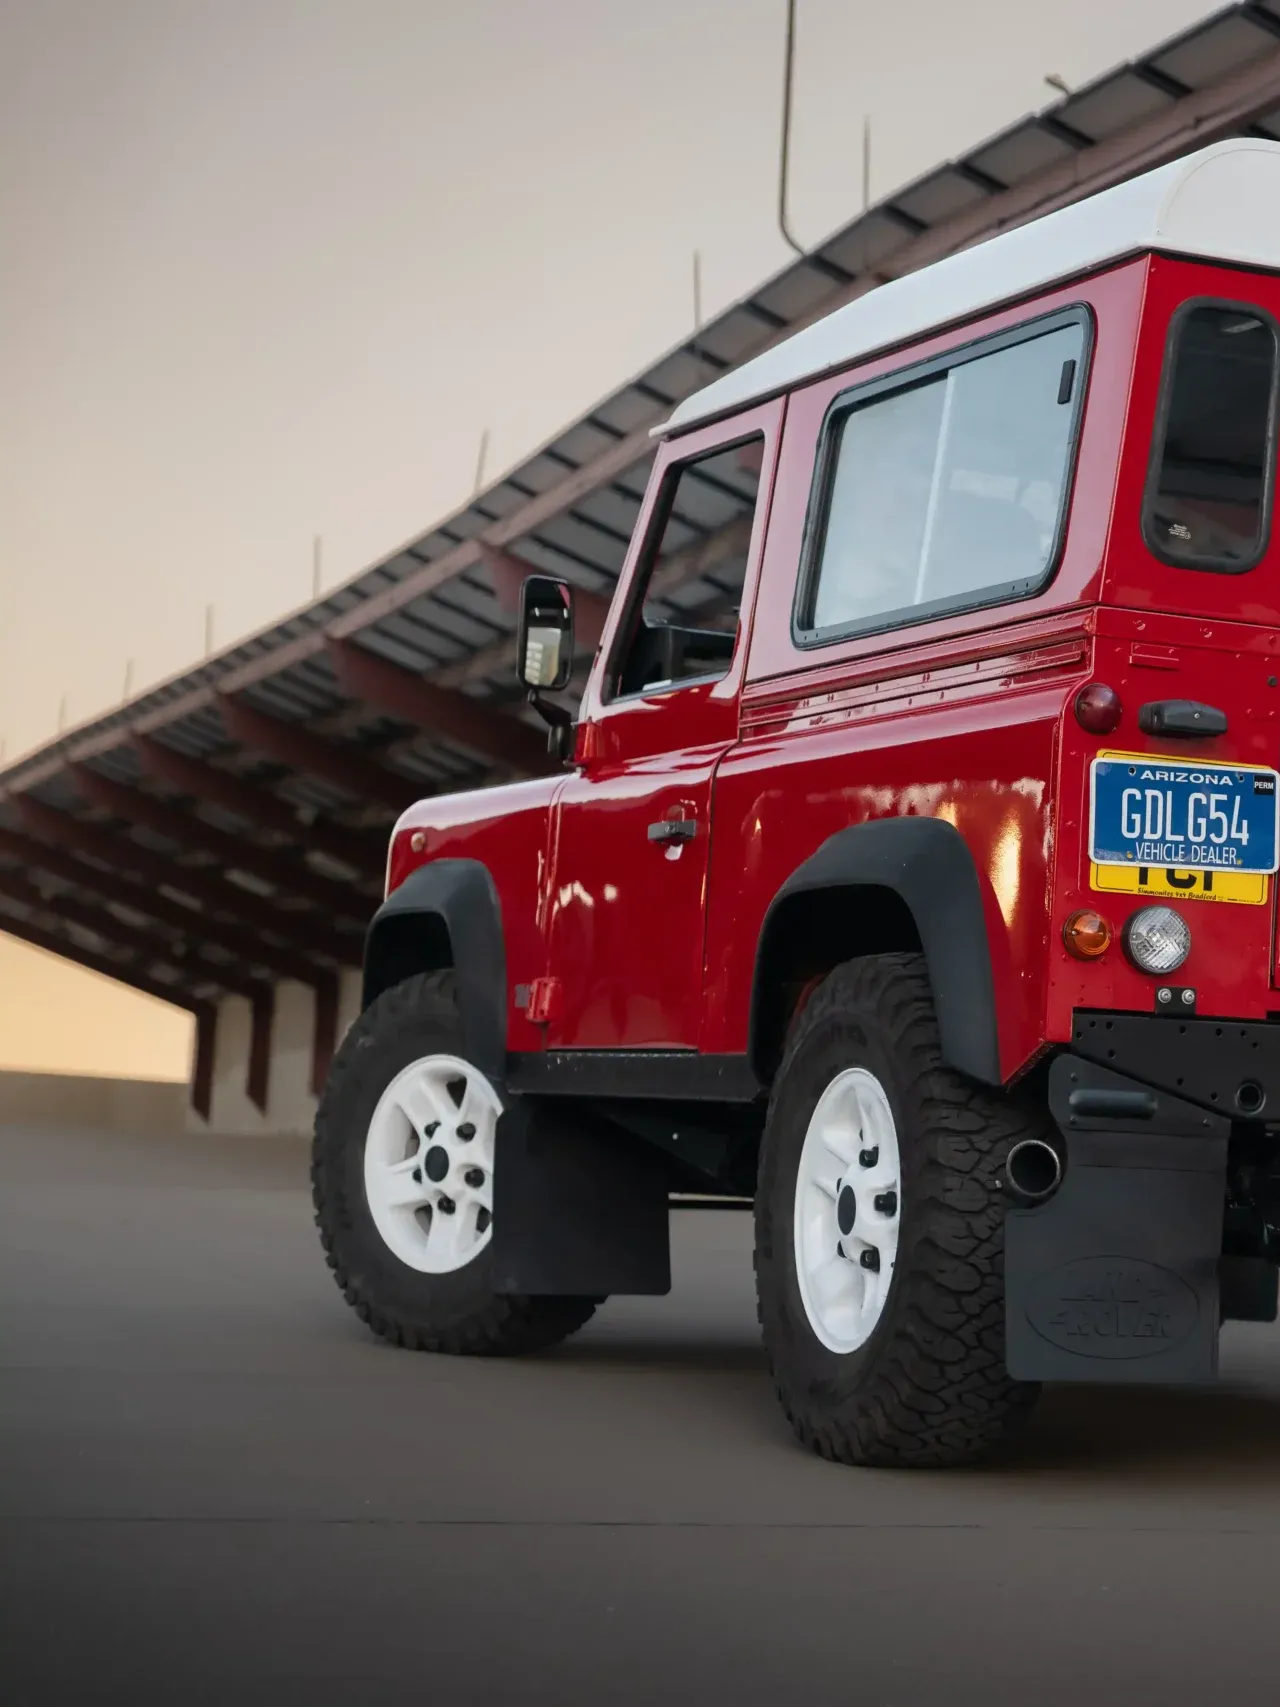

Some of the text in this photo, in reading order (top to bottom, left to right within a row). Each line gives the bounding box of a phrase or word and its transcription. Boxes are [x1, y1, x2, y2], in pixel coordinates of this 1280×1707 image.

[1140, 770, 1233, 786] ARIZONA
[1254, 781, 1274, 790] PERM
[1121, 788, 1249, 845] GDLG54
[1136, 842, 1237, 865] VEHICLE DEALER
[1188, 892, 1217, 901] Bradford
